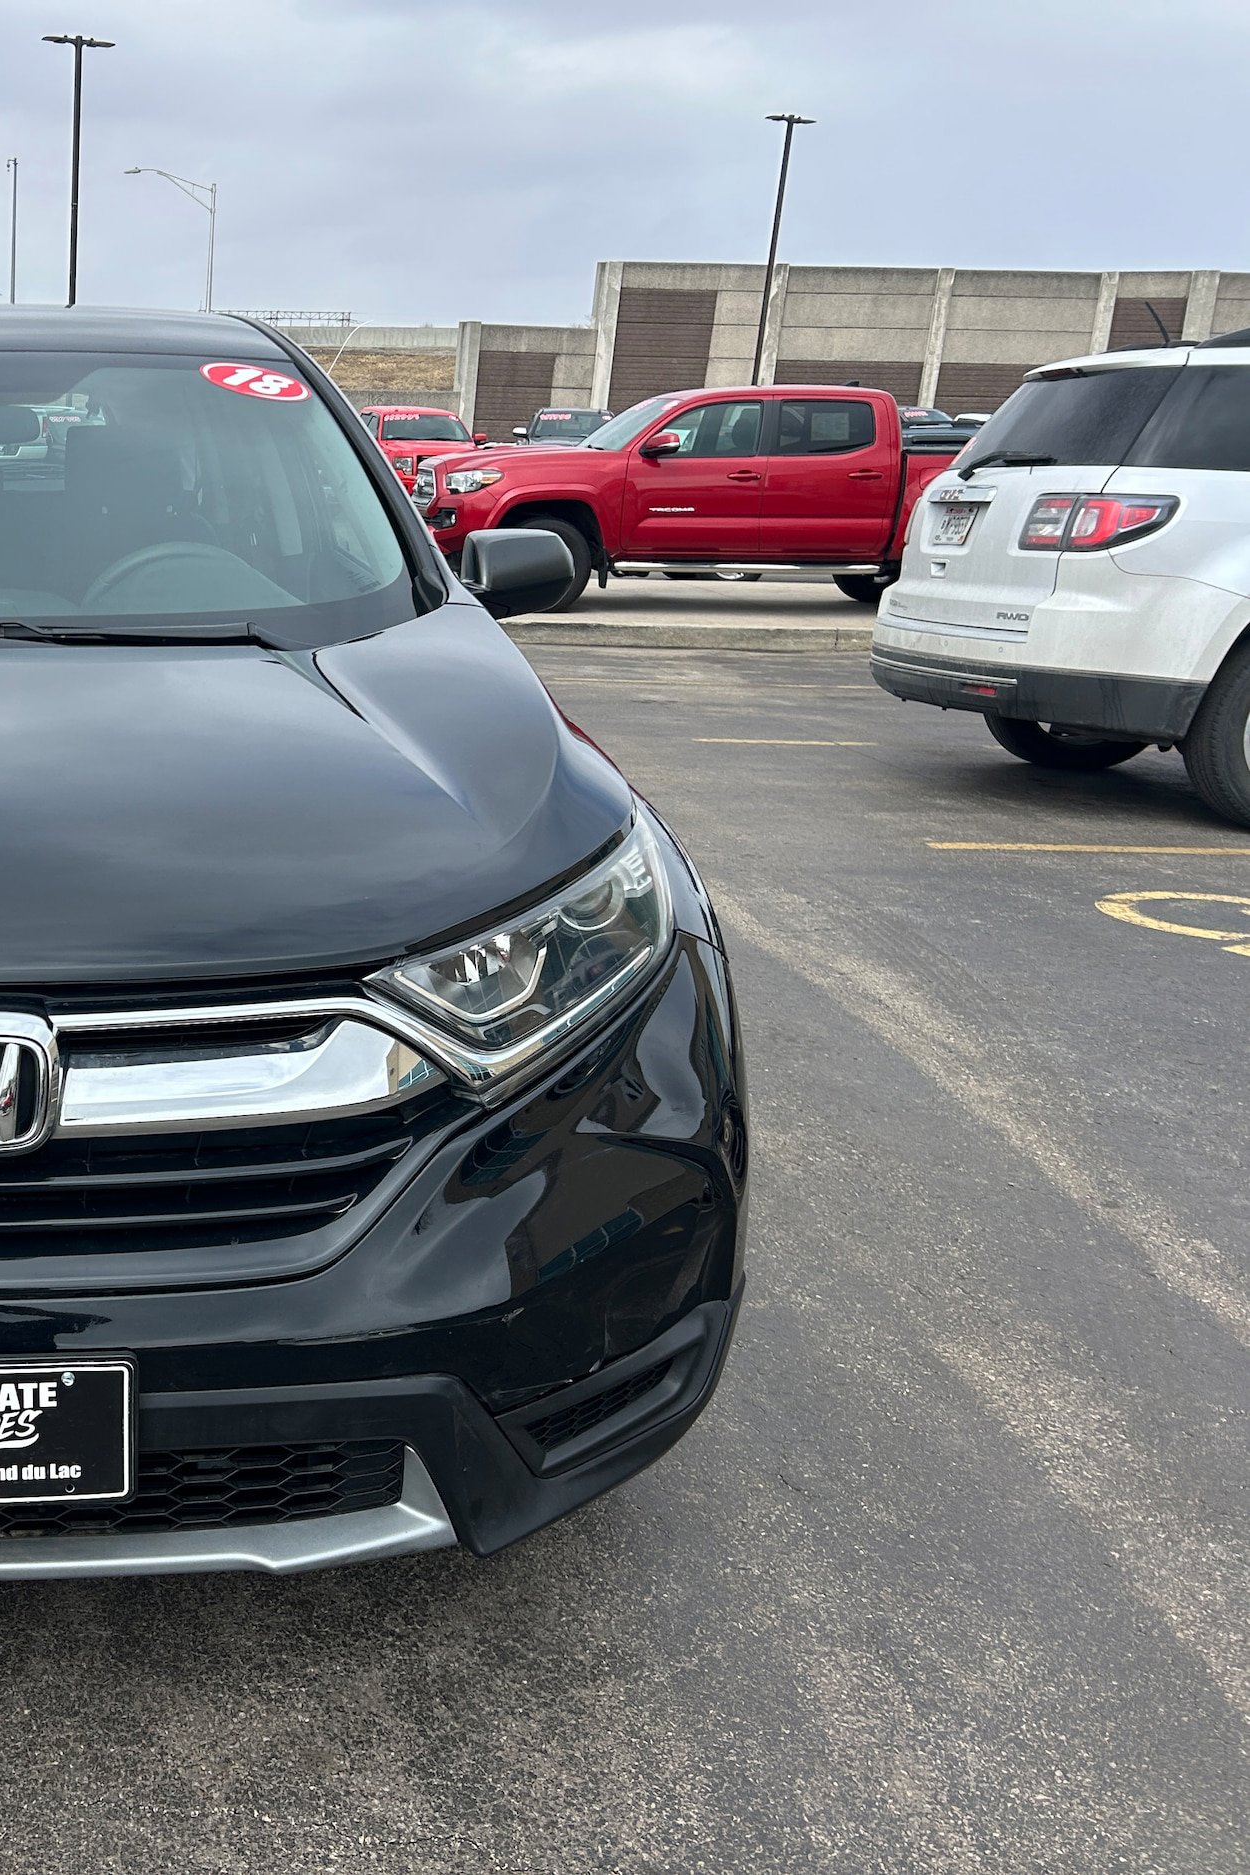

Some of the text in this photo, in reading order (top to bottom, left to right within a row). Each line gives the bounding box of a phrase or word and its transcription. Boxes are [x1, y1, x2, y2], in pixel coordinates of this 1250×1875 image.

[222, 368, 295, 395] 18
[22, 1464, 46, 1480] du
[50, 1463, 81, 1480] Lac
